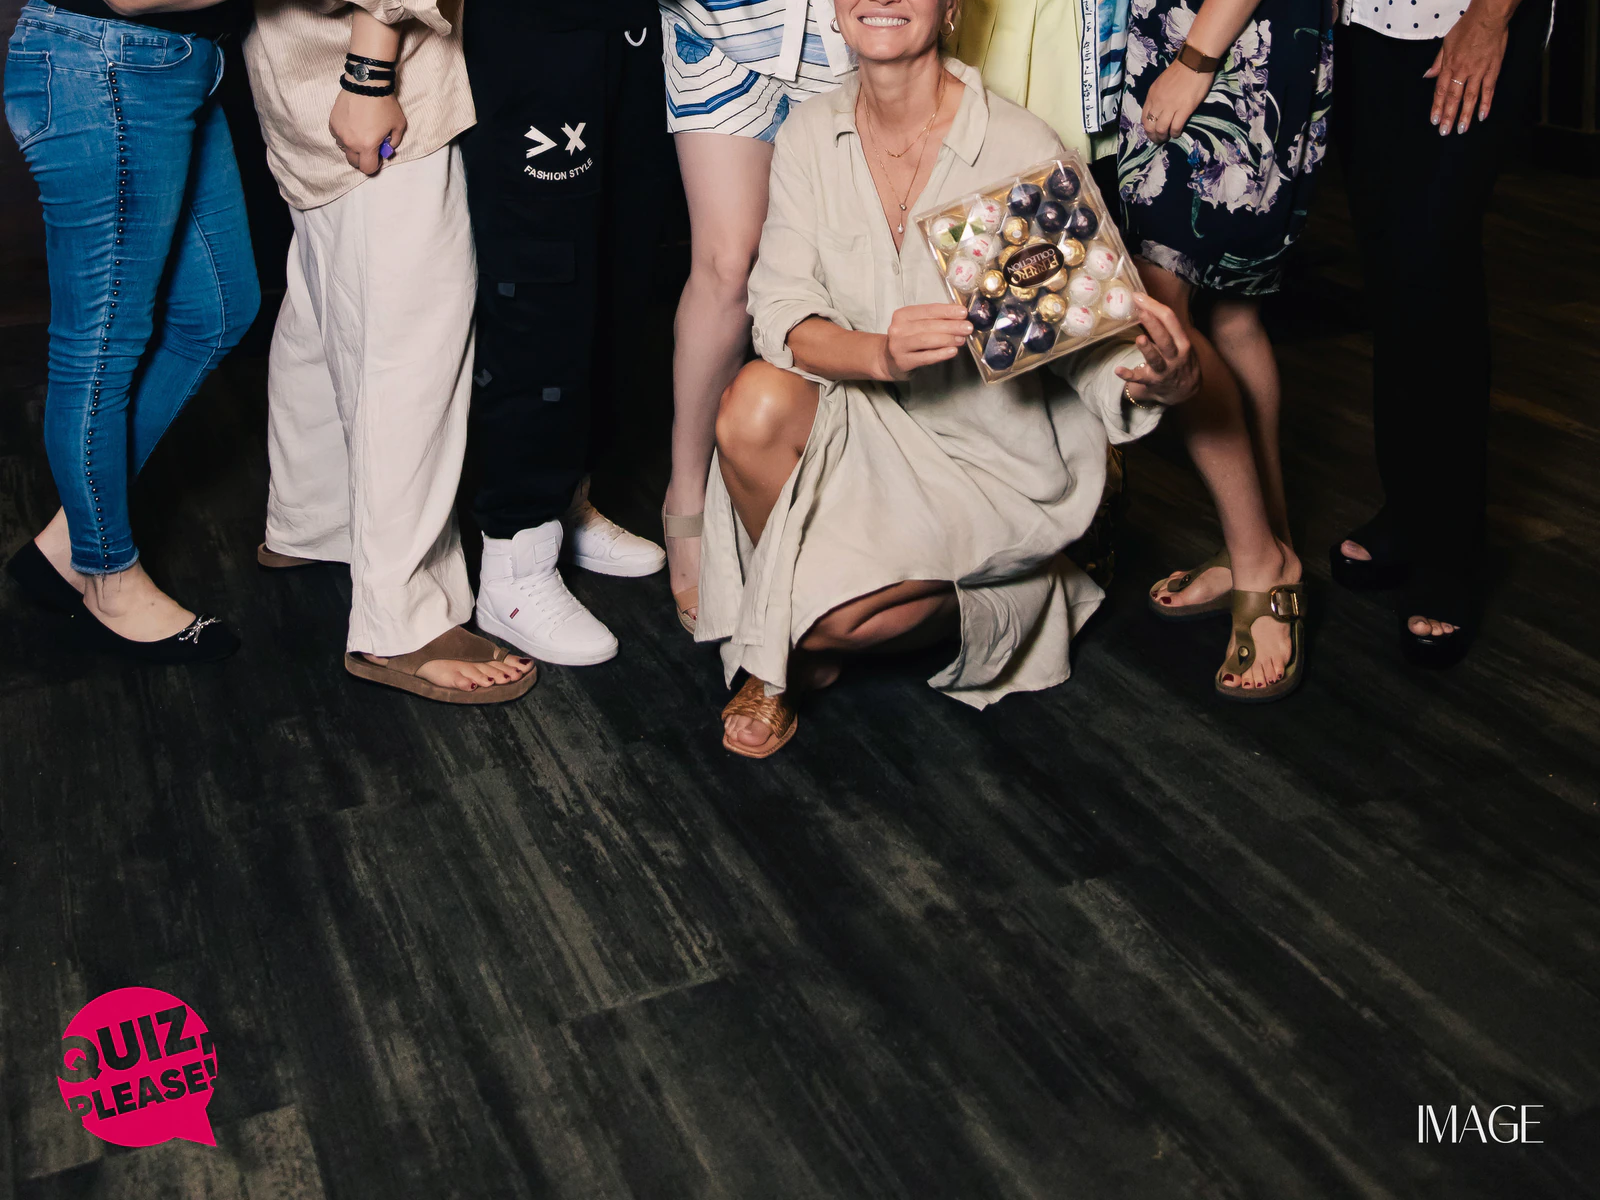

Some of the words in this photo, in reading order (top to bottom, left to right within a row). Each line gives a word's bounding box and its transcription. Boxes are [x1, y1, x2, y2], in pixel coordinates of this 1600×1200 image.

[523, 165, 567, 181] FASHION
[569, 157, 594, 178] STYLE
[1006, 248, 1055, 274] COLLECTION
[1010, 254, 1060, 284] FERRERO
